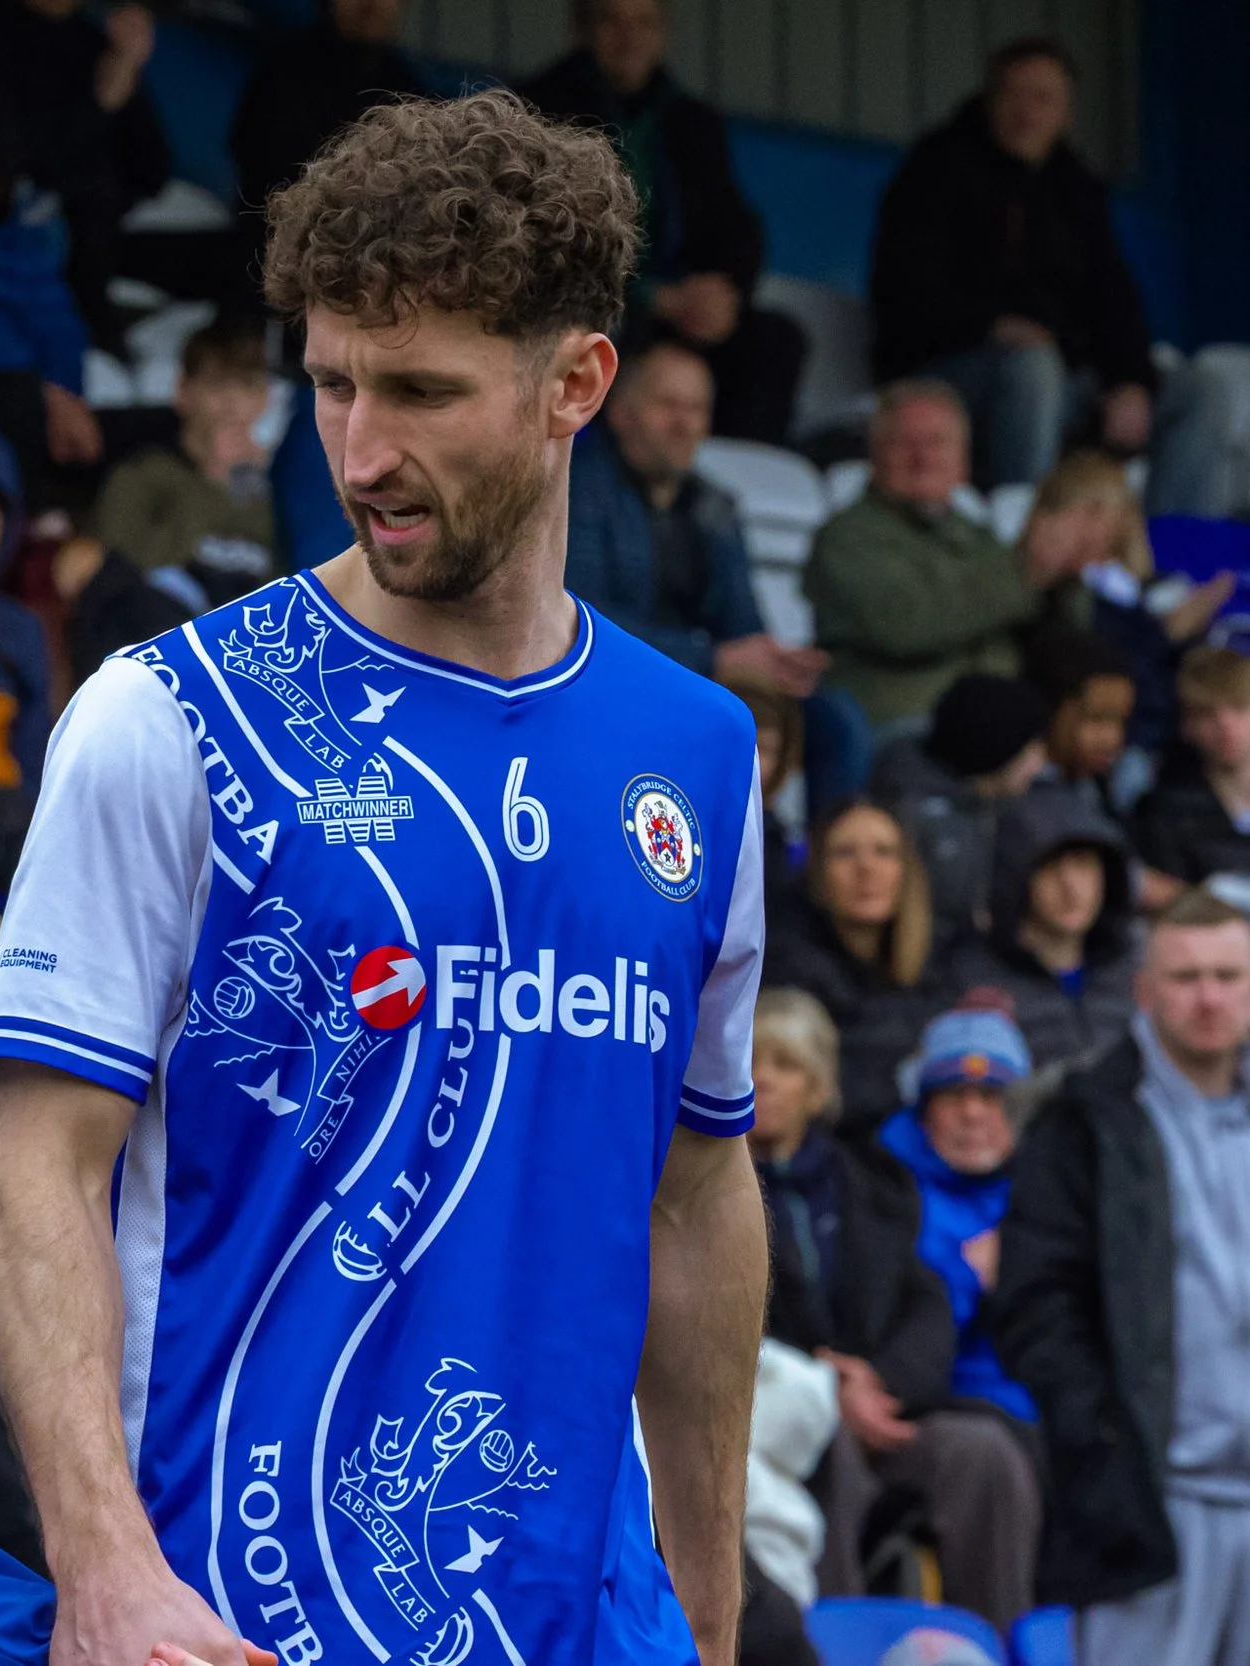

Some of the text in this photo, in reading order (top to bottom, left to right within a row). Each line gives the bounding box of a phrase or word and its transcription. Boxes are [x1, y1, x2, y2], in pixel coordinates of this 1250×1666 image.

[231, 657, 311, 713] ABSQUE
[304, 733, 345, 770] LAB
[302, 799, 409, 821] MATCHWINNER
[502, 756, 551, 862] 6
[627, 781, 696, 830] STALYBRIDGE CELTIC
[641, 860, 696, 895] FOOTBALL CLUB
[0, 958, 57, 974] EQUIPMENT
[2, 947, 58, 964] CLEANING
[436, 944, 671, 1054] Fidelis
[335, 1033, 381, 1082] NIHI
[427, 968, 479, 1148] CLU
[308, 1115, 339, 1157] ORE
[338, 1489, 406, 1559] ABSQUE
[238, 1439, 324, 1666] FOOTB
[391, 1582, 428, 1624] LAB
